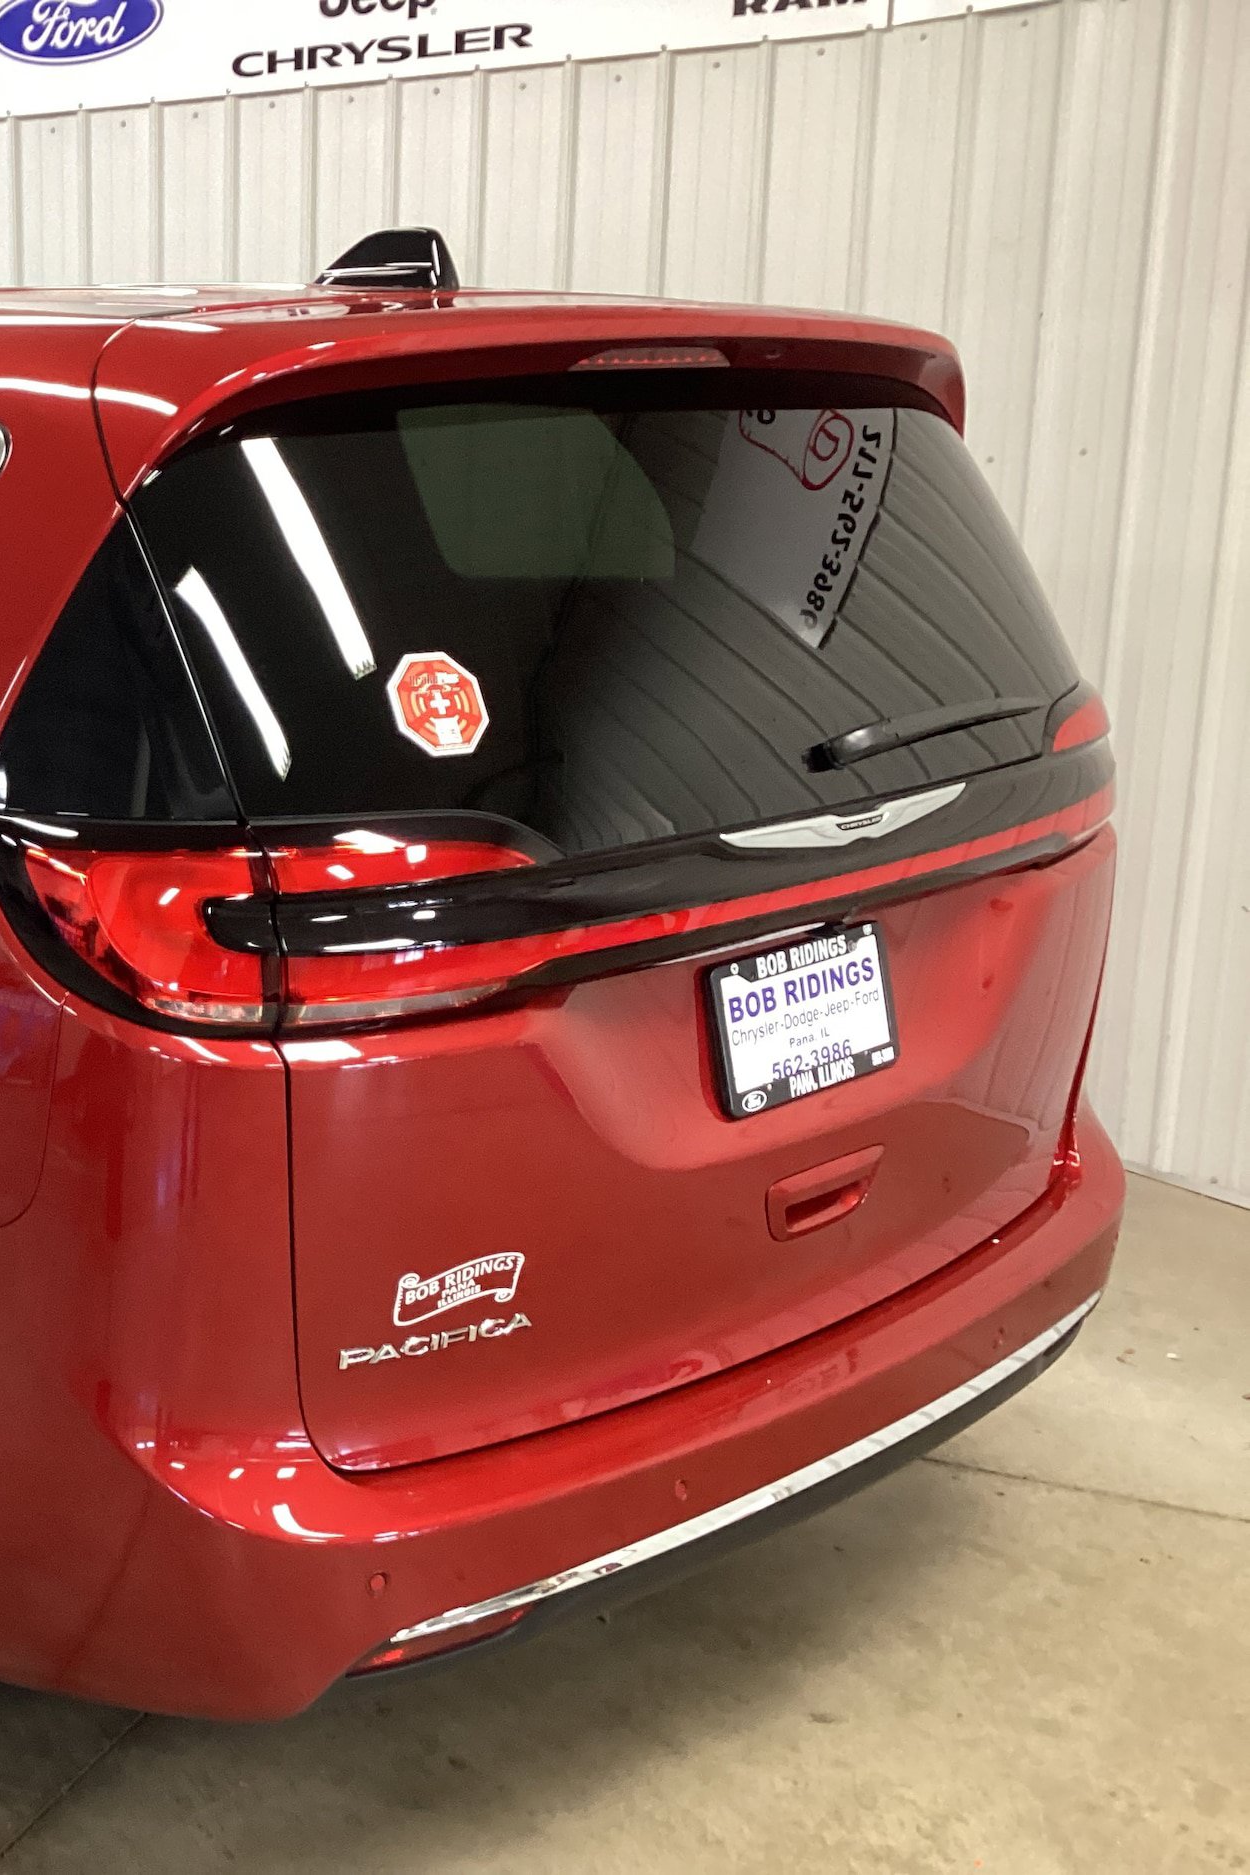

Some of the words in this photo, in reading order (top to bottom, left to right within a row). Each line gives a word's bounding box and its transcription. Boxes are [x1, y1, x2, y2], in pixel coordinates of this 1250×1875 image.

[22, 0, 127, 51] Ford
[232, 22, 533, 77] CHRYSLER
[755, 950, 788, 979] BOB
[789, 934, 847, 969] RIDINGS
[728, 986, 777, 1024] BOB
[783, 956, 875, 1006] RIDINGS
[820, 1026, 831, 1039] IL
[772, 1039, 852, 1081] 562-3986
[404, 1280, 440, 1306] BOB
[444, 1256, 516, 1290] RIDINGS
[437, 1284, 482, 1309] ILLINOIS
[441, 1278, 476, 1299] PANA
[338, 1311, 533, 1371] PACIFICA
